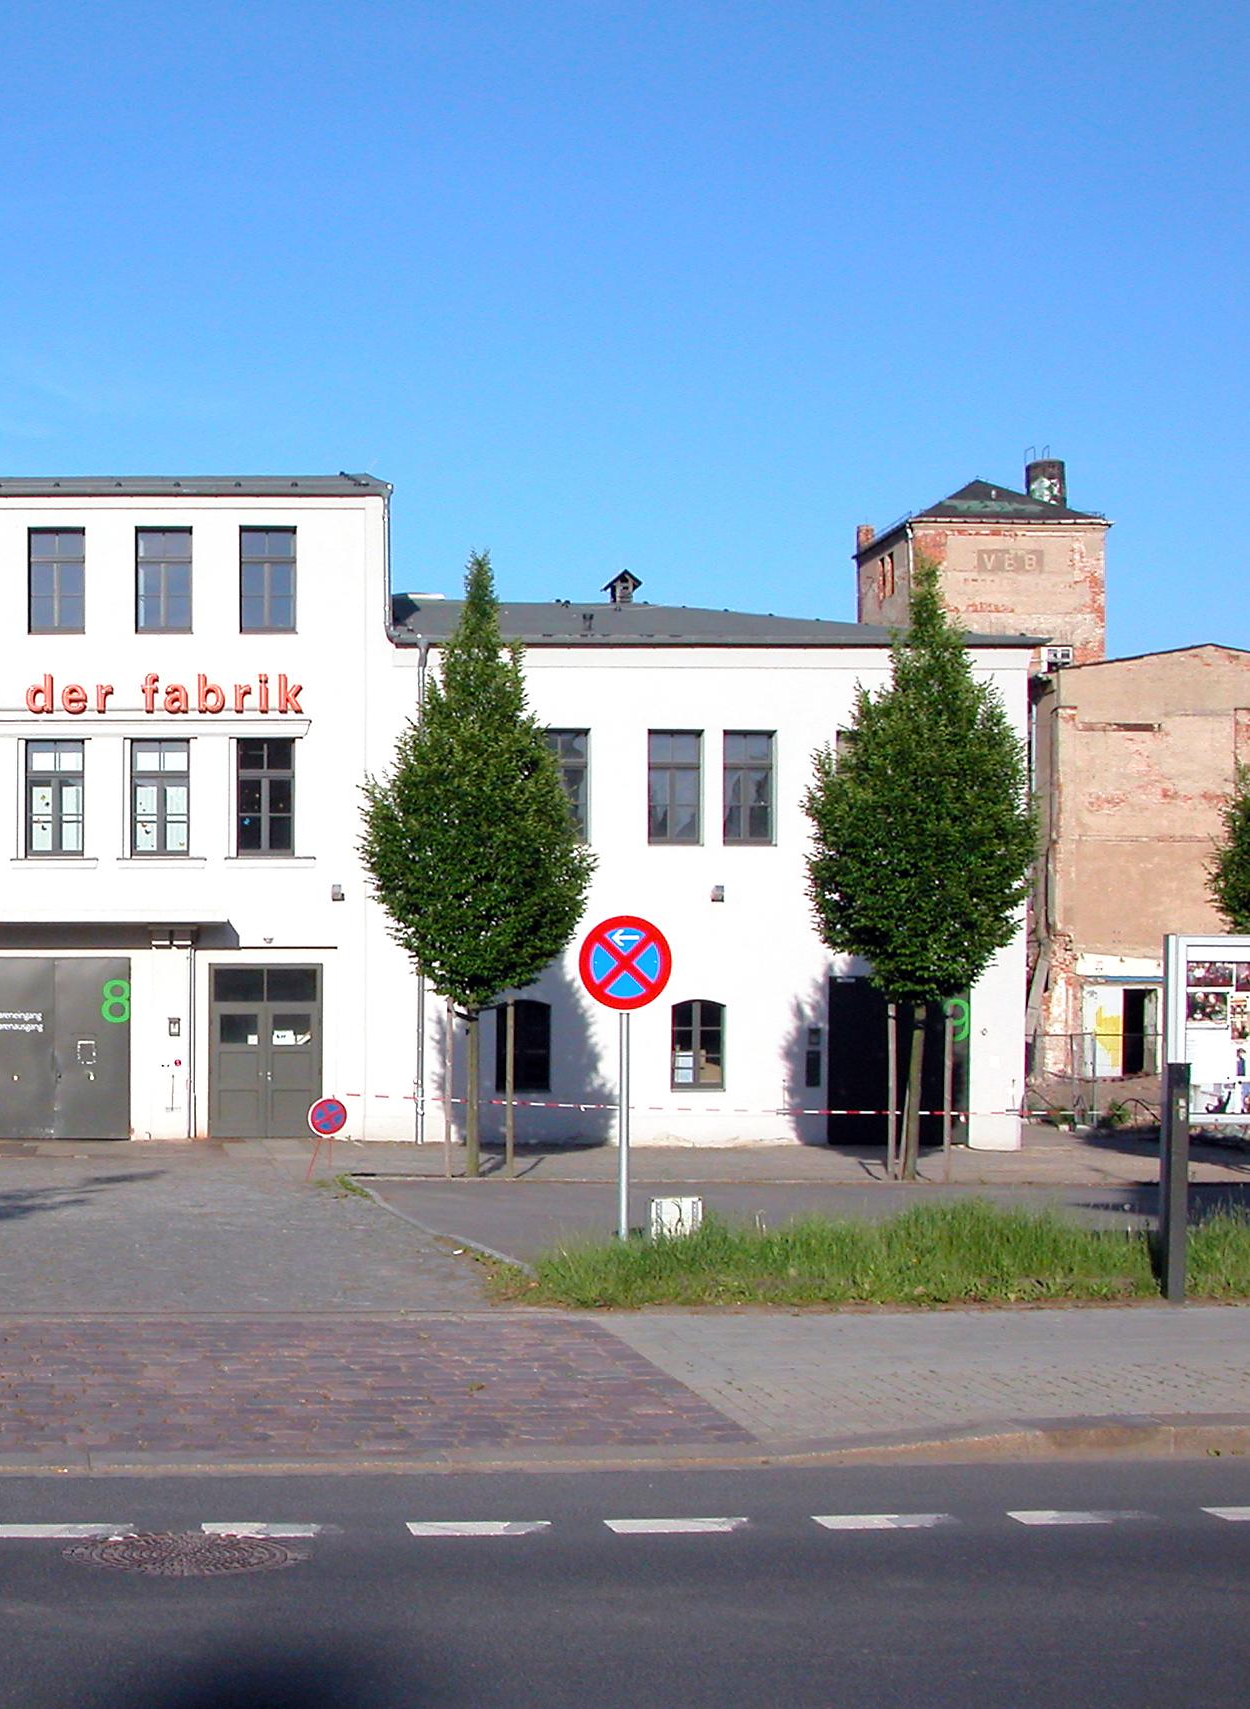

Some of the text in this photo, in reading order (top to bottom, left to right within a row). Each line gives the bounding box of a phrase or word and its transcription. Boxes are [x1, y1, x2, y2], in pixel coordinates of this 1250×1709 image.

[983, 553, 1037, 571] VEB
[25, 673, 113, 714] der
[141, 673, 303, 714] fabrik
[100, 978, 131, 1024] 8
[942, 998, 970, 1042] 9
